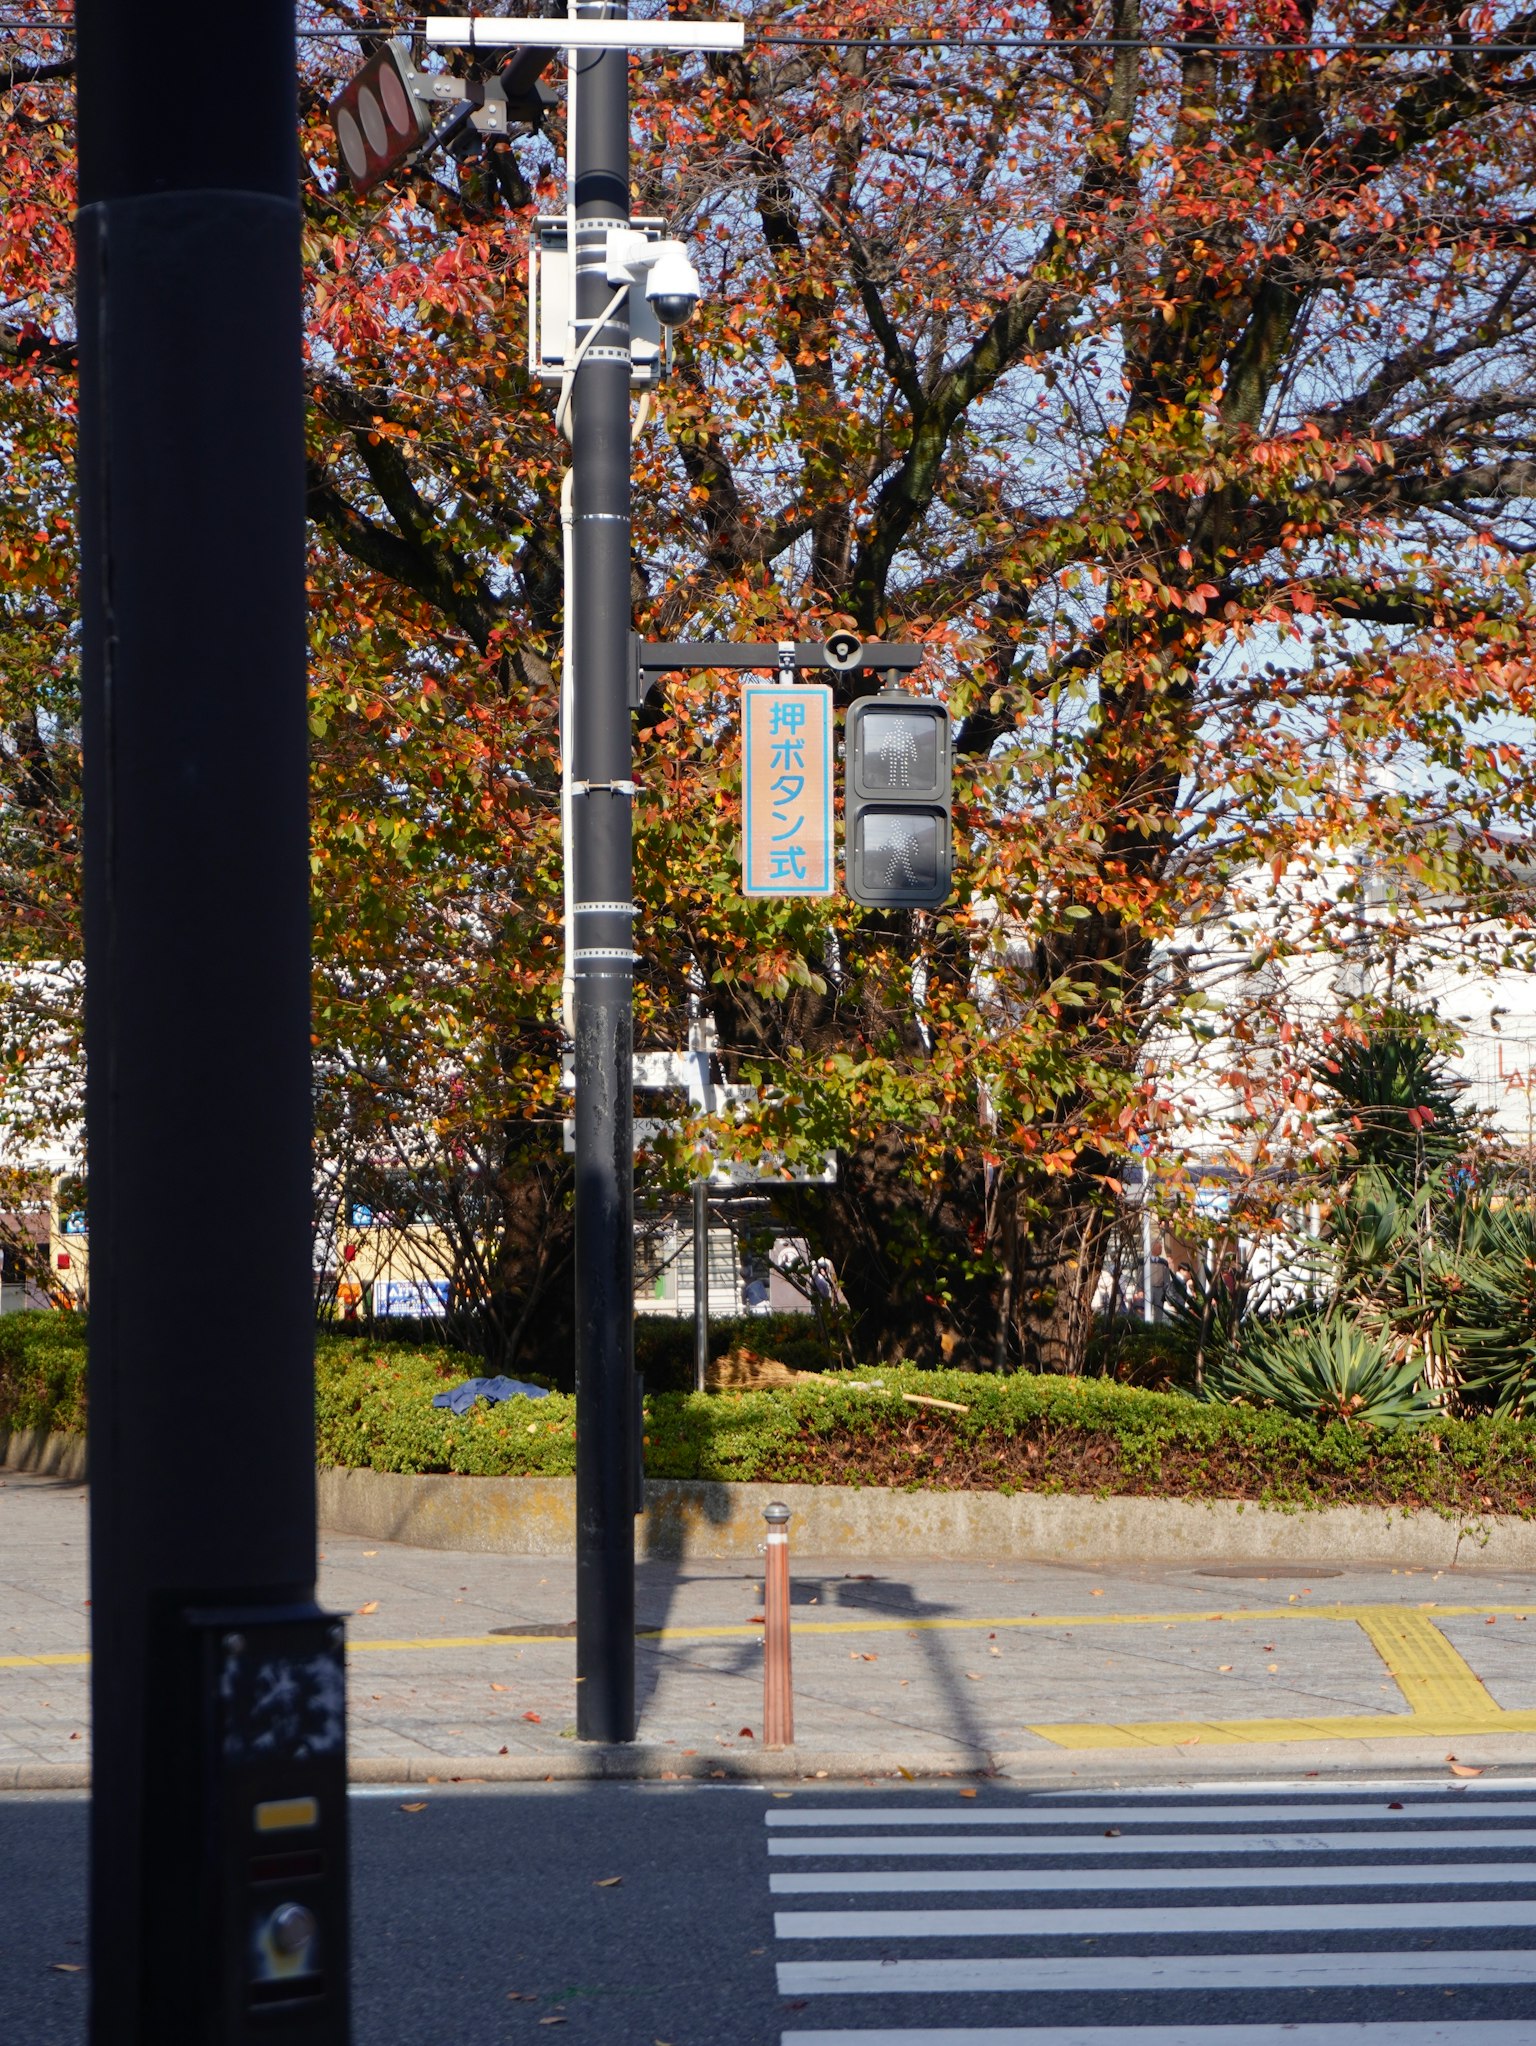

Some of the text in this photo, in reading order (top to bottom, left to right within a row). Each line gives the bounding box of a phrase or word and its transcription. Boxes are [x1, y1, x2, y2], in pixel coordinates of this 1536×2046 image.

[769, 701, 807, 880] 押ボタン式
